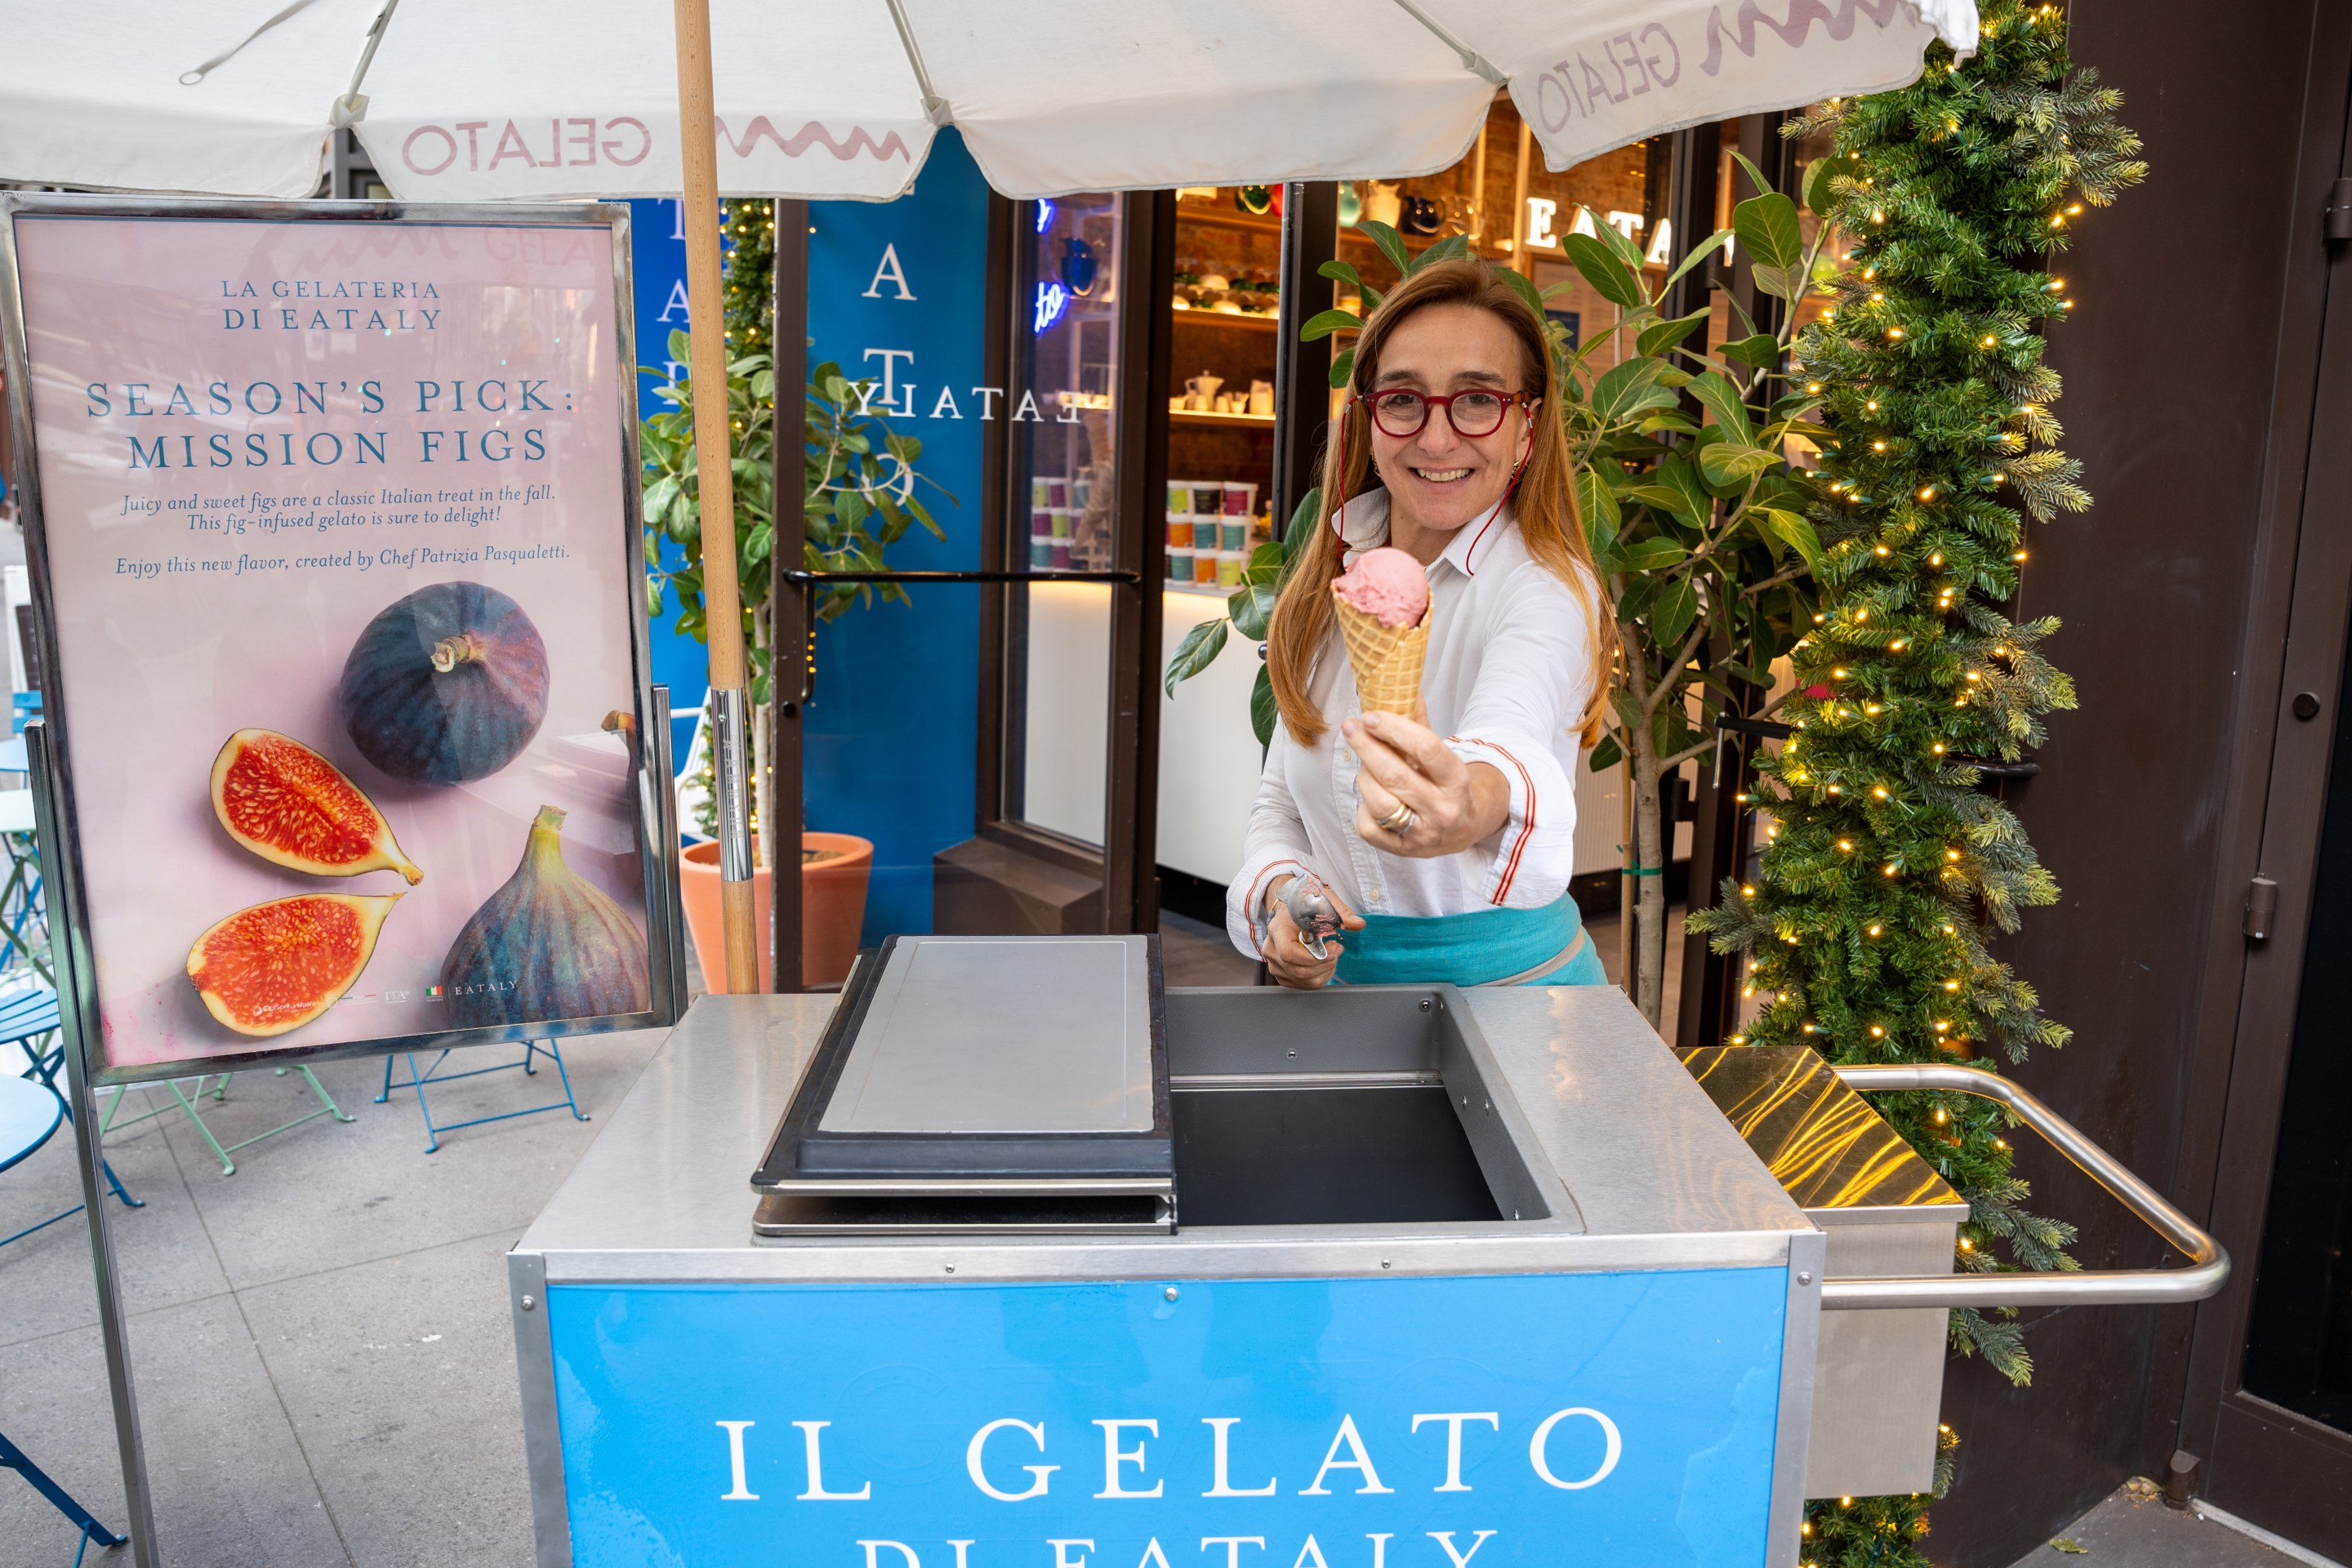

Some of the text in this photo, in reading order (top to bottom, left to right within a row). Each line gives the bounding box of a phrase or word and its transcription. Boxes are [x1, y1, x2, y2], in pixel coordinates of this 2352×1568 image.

[220, 280, 440, 299] LA GELATERIA
[222, 308, 442, 330] DI EATALY
[87, 379, 572, 418] SEASON'S PICK:
[125, 428, 546, 469] MISSION FIGS
[119, 483, 555, 517] Juicy and sweet figs are a classic Italian treat in the fall.
[186, 505, 501, 536] This fig-infused gelato is sure to delight!
[115, 543, 570, 580] Enjoy this new flavor, created by Chef Patrizia Pasqualetti.
[454, 980, 519, 996] EATALY
[715, 1406, 1623, 1502] IL GELATO
